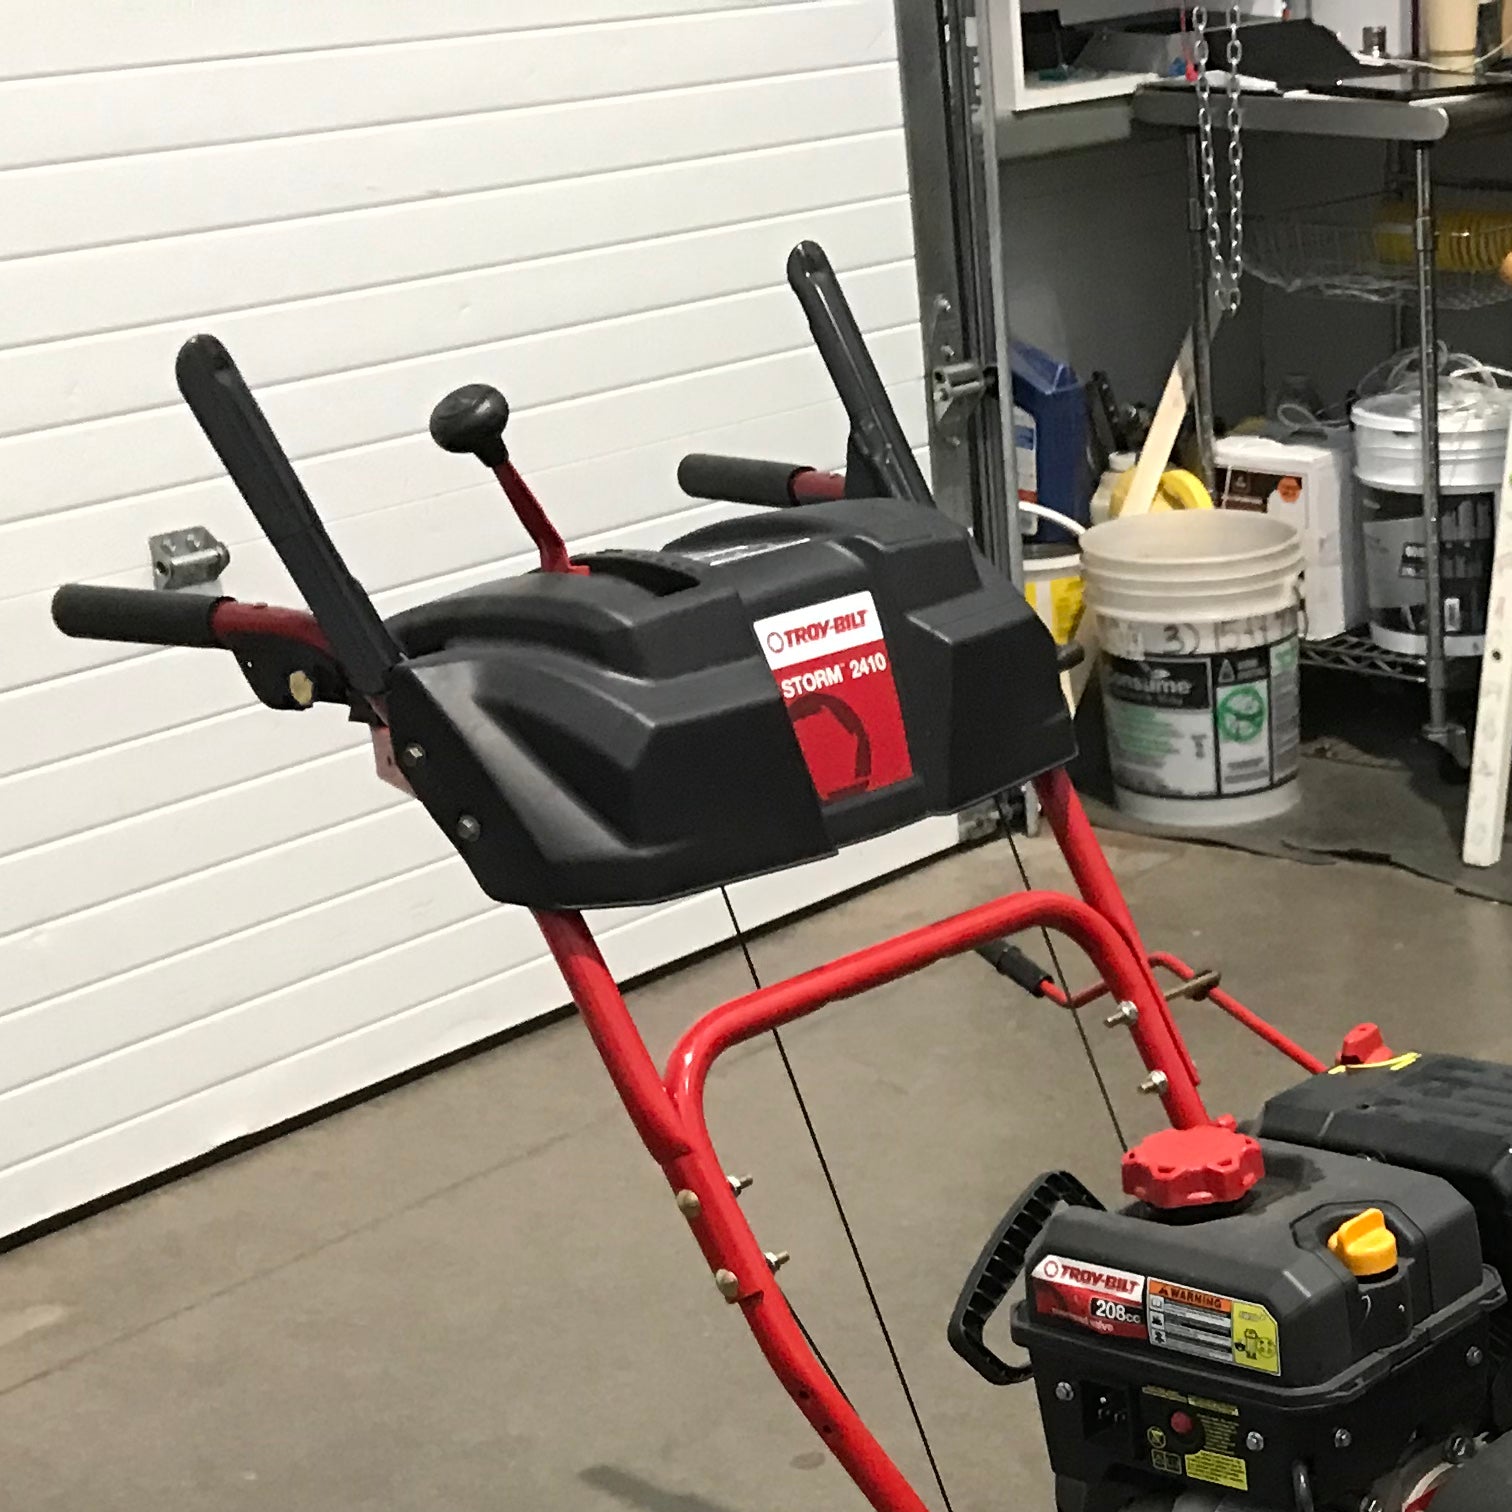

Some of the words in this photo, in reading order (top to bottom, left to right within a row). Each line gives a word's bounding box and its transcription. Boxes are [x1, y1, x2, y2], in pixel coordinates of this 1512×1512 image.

[784, 609, 868, 648] TROY-BILT
[781, 664, 844, 698] STORM
[849, 652, 887, 679] 2410
[1061, 1264, 1140, 1295] TROY-BILT
[1170, 1286, 1222, 1309] WARNING
